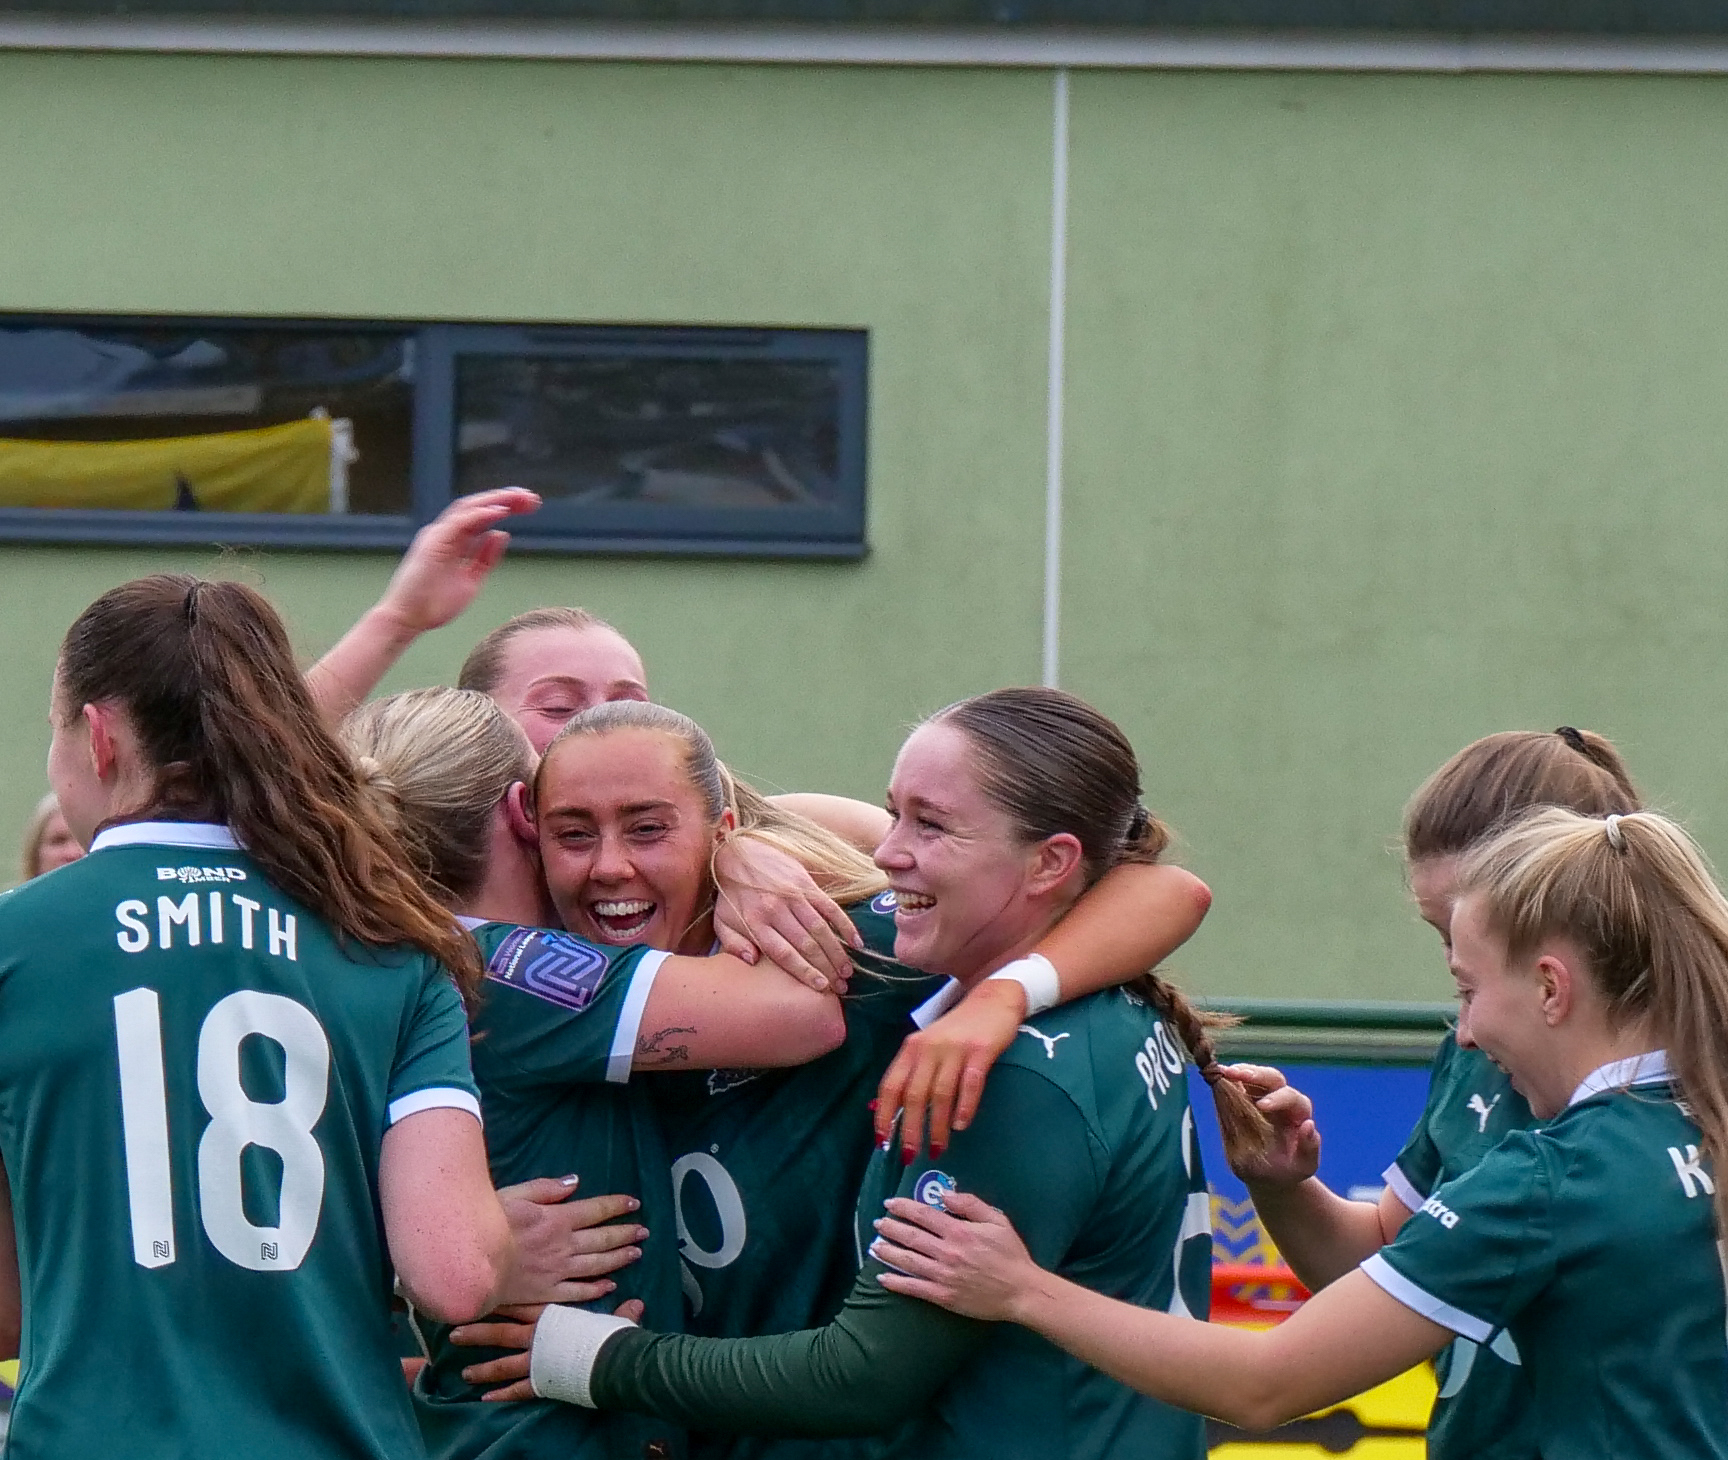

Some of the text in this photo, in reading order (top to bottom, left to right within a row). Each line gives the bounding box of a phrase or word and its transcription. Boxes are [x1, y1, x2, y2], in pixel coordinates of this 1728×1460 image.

[114, 891, 298, 962] SMITH
[1135, 1020, 1186, 1111] PRO
[113, 986, 330, 1271] 18
